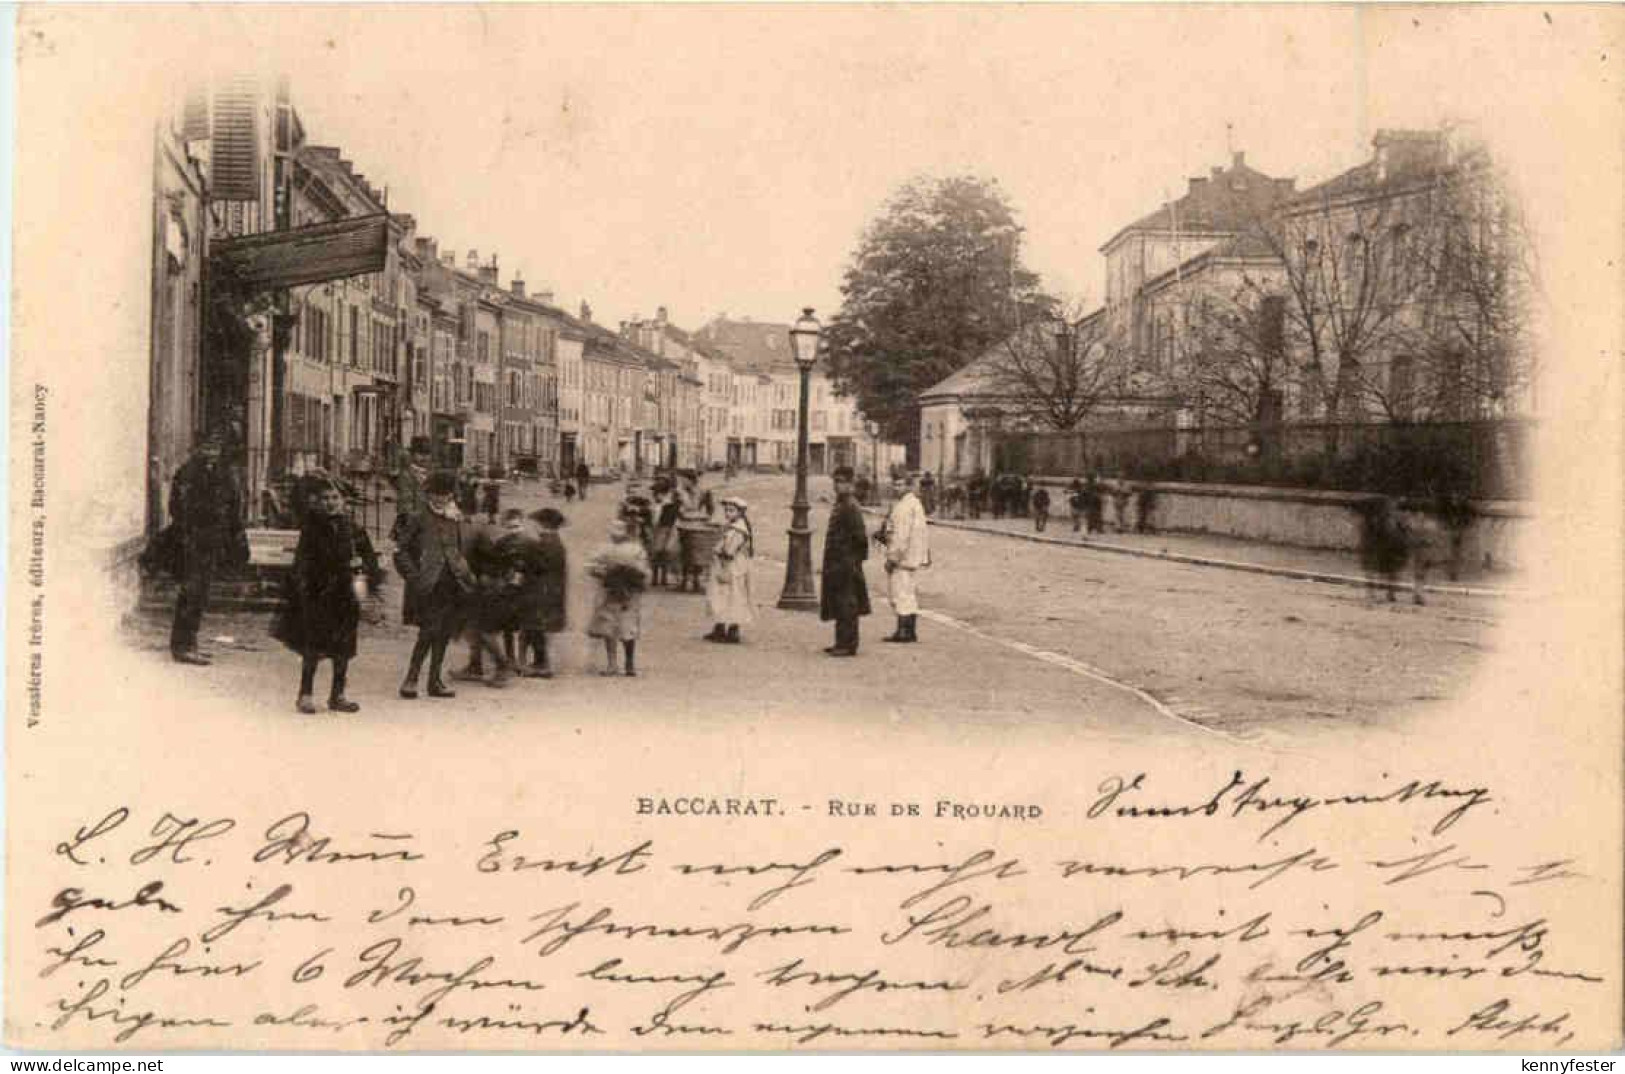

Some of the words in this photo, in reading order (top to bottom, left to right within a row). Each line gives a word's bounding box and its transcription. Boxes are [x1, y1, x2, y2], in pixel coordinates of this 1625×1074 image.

[31, 383, 49, 508] Baccarat-Nancy
[29, 514, 47, 588] éditeurs,
[636, 798, 786, 817] BACCARAT.
[934, 800, 1044, 820] FROUARD
